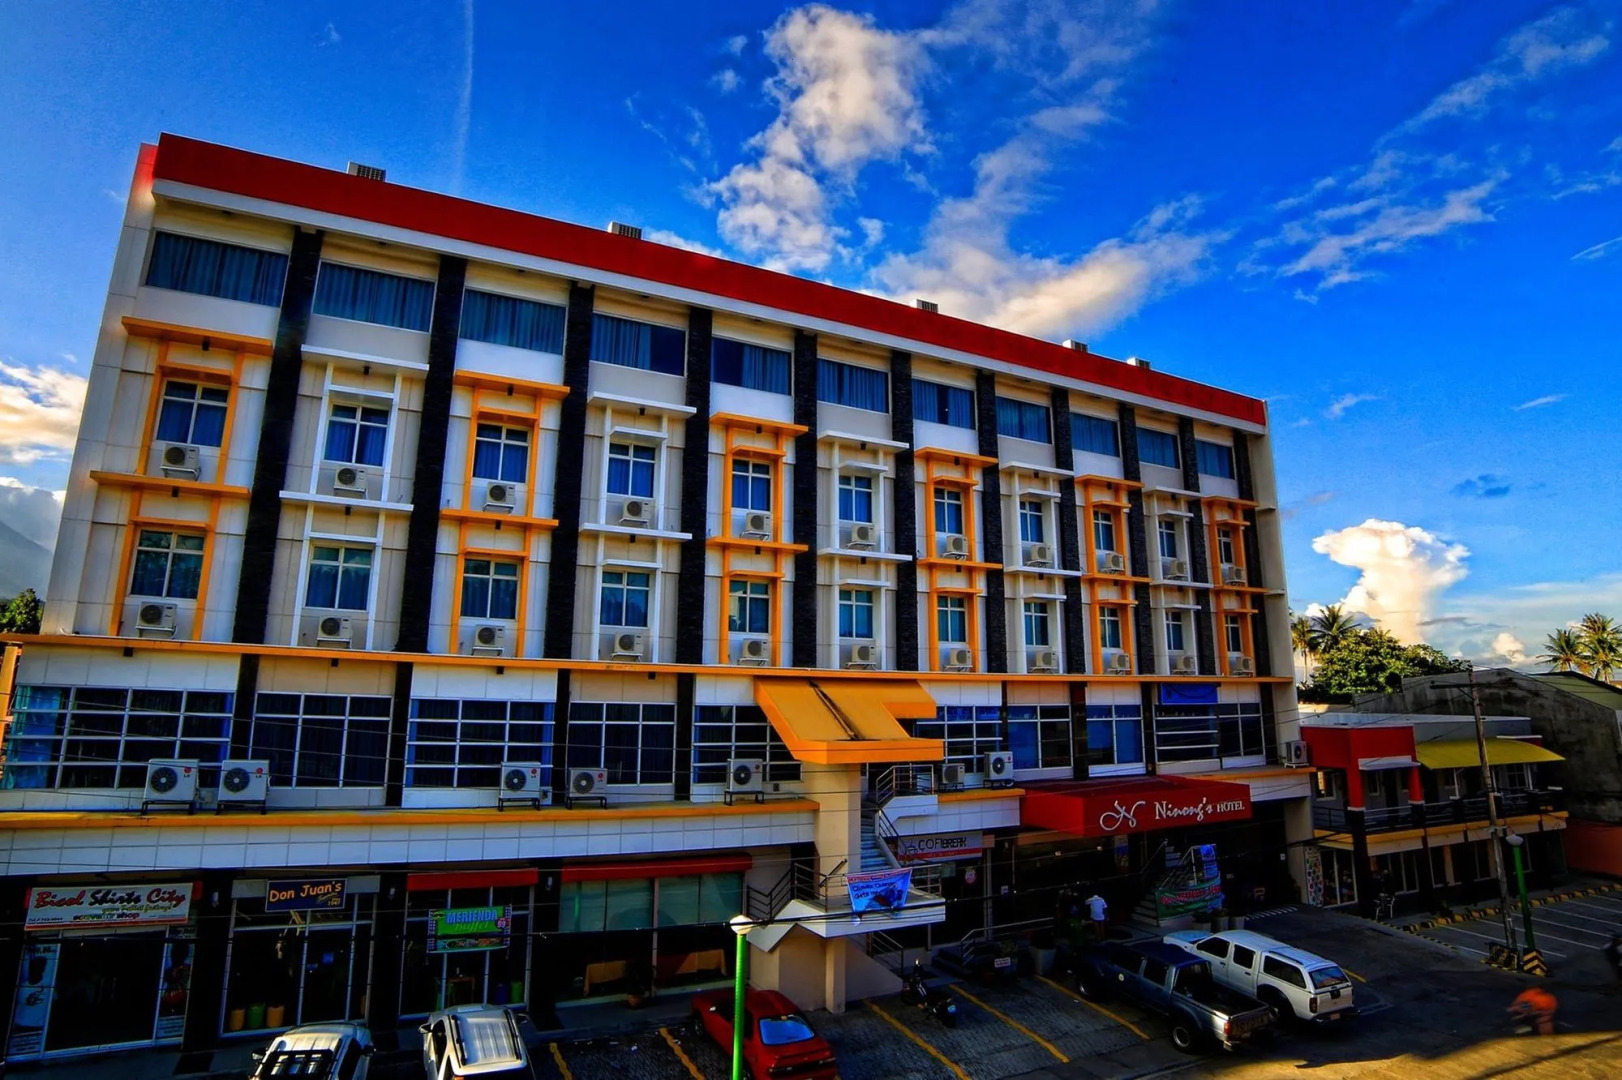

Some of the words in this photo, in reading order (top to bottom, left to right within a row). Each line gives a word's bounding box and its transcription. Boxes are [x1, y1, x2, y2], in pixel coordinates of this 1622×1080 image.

[1153, 797, 1214, 822] Ninong's
[1216, 800, 1245, 813] HOTEL
[35, 889, 86, 909] Bicol
[88, 889, 142, 906] Shirts
[147, 888, 186, 907] City
[269, 889, 296, 902] Don
[300, 881, 342, 897] Juan's
[446, 909, 498, 924] MERIENDA
